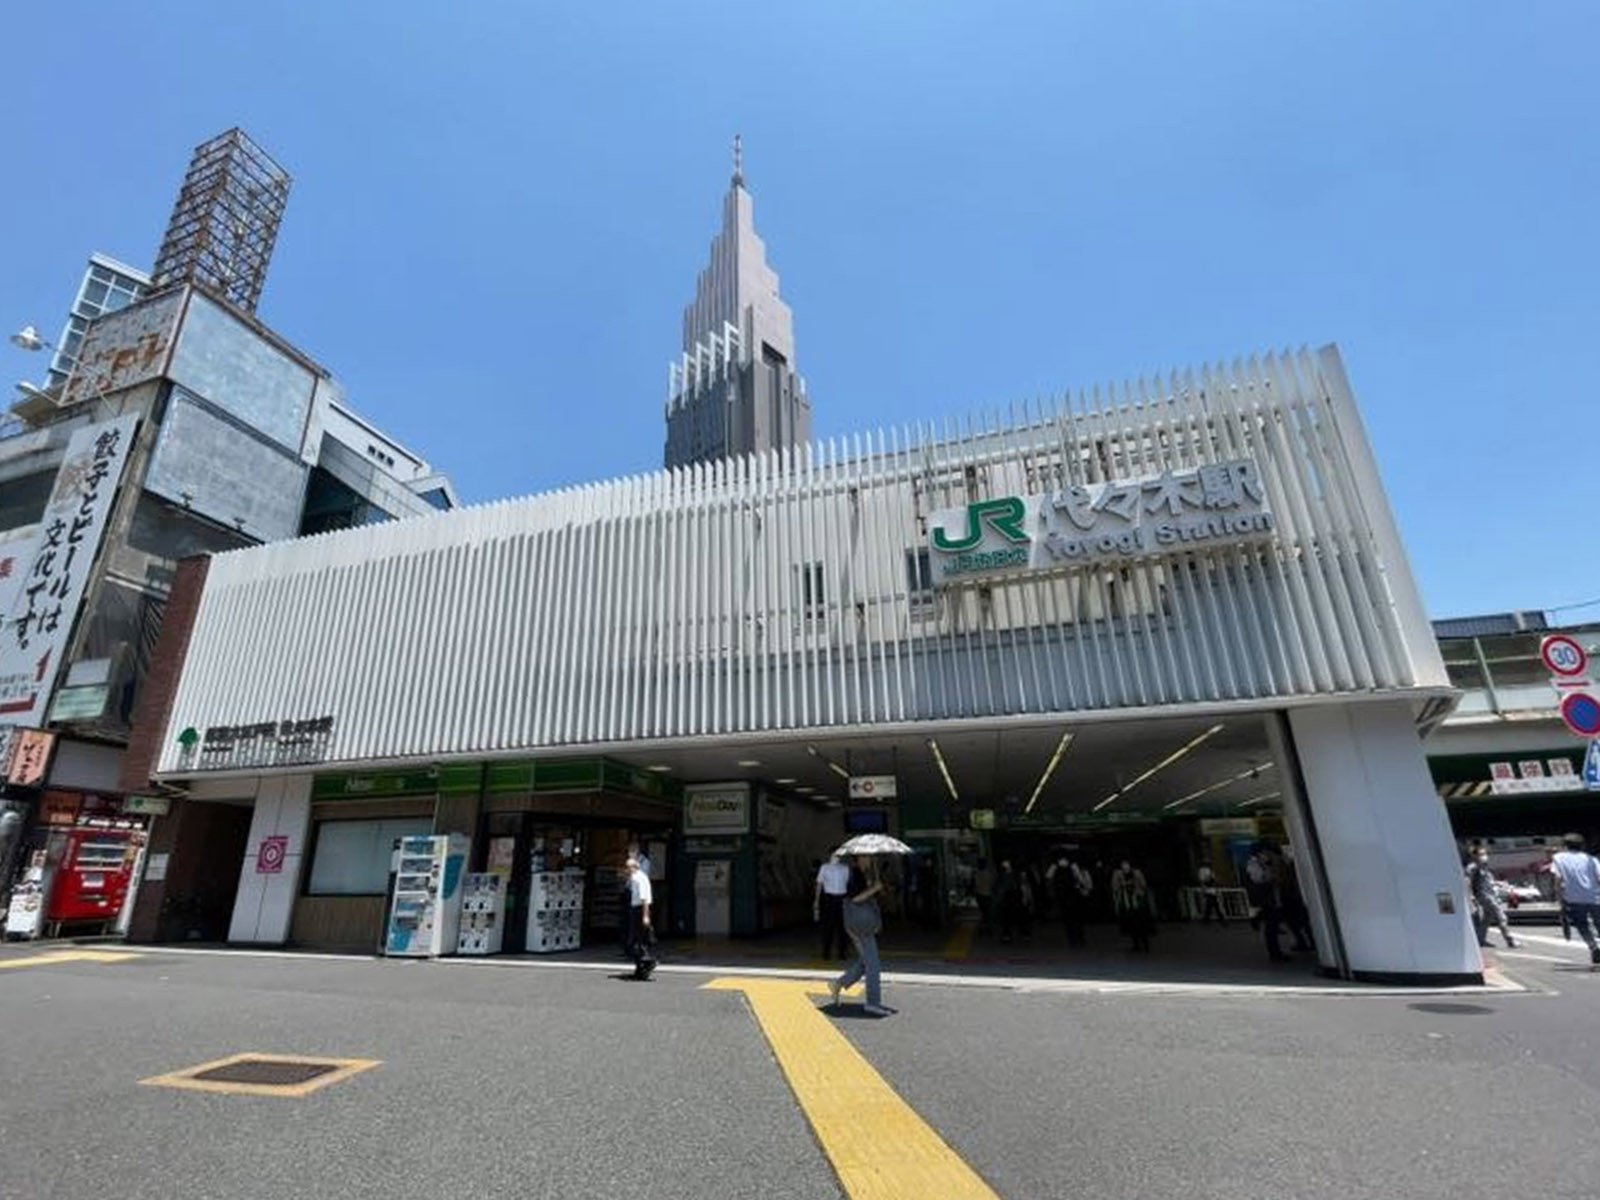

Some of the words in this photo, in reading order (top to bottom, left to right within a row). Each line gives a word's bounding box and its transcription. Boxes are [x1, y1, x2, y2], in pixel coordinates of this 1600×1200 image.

[1039, 461, 1263, 531] 代々木駅
[931, 496, 1030, 551] JR
[1045, 525, 1145, 560] Yoyogi
[1155, 512, 1274, 545] Station
[1551, 645, 1577, 665] 30
